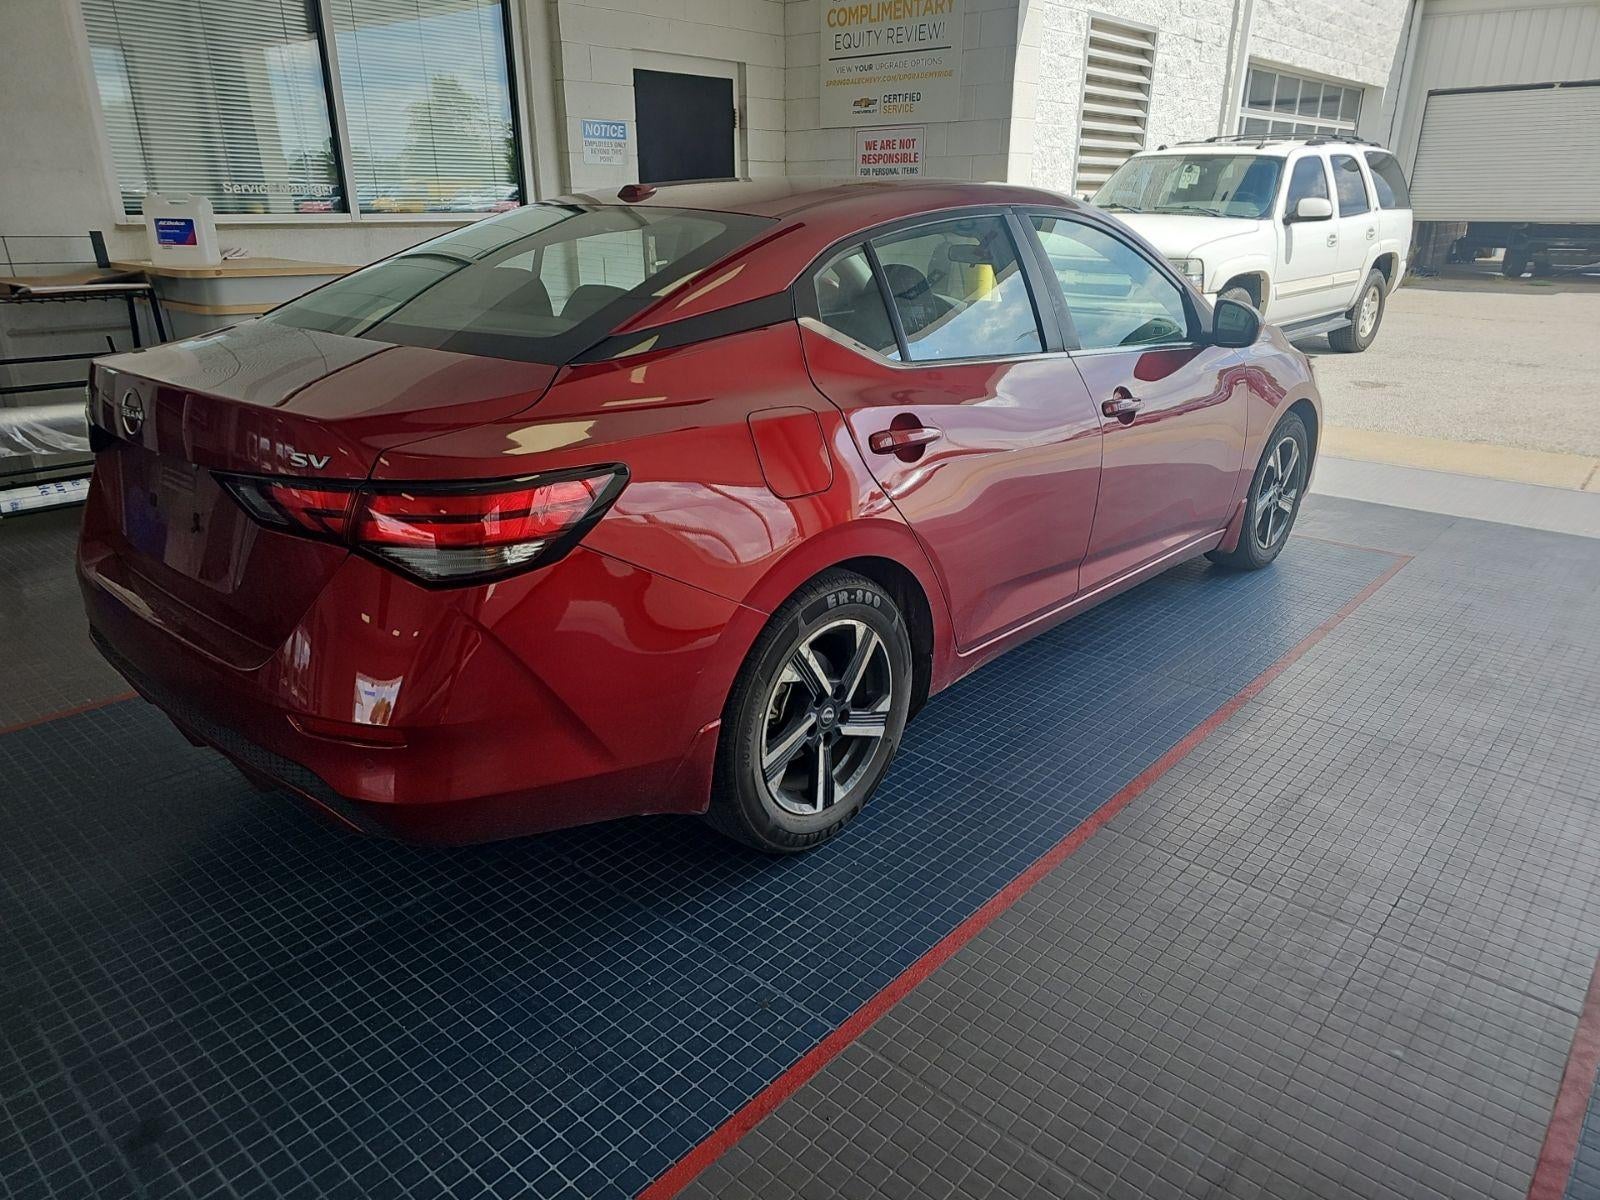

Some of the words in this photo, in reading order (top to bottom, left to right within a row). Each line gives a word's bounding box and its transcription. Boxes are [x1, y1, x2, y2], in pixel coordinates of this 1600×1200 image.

[827, 0, 954, 28] COMPLIMENTARY
[834, 29, 882, 51] EQUITY
[886, 21, 946, 45] REVIEW!
[835, 66, 852, 75] VIEW
[854, 63, 874, 73] YOUR
[875, 60, 909, 71] UPGRADE
[910, 56, 943, 68] OPTIONS
[882, 92, 922, 104] CERTIFIED
[882, 103, 914, 115] SERVICE
[585, 122, 625, 138] NOTICE
[864, 140, 878, 151] WE
[879, 139, 897, 151] ARE
[899, 138, 917, 150] NOT
[861, 152, 919, 165] RESPONSIBLE
[860, 167, 871, 176] FOR
[872, 166, 900, 176] PERSONAL
[901, 166, 919, 175] ITEMS
[222, 181, 270, 195] Service
[289, 451, 332, 470] SV
